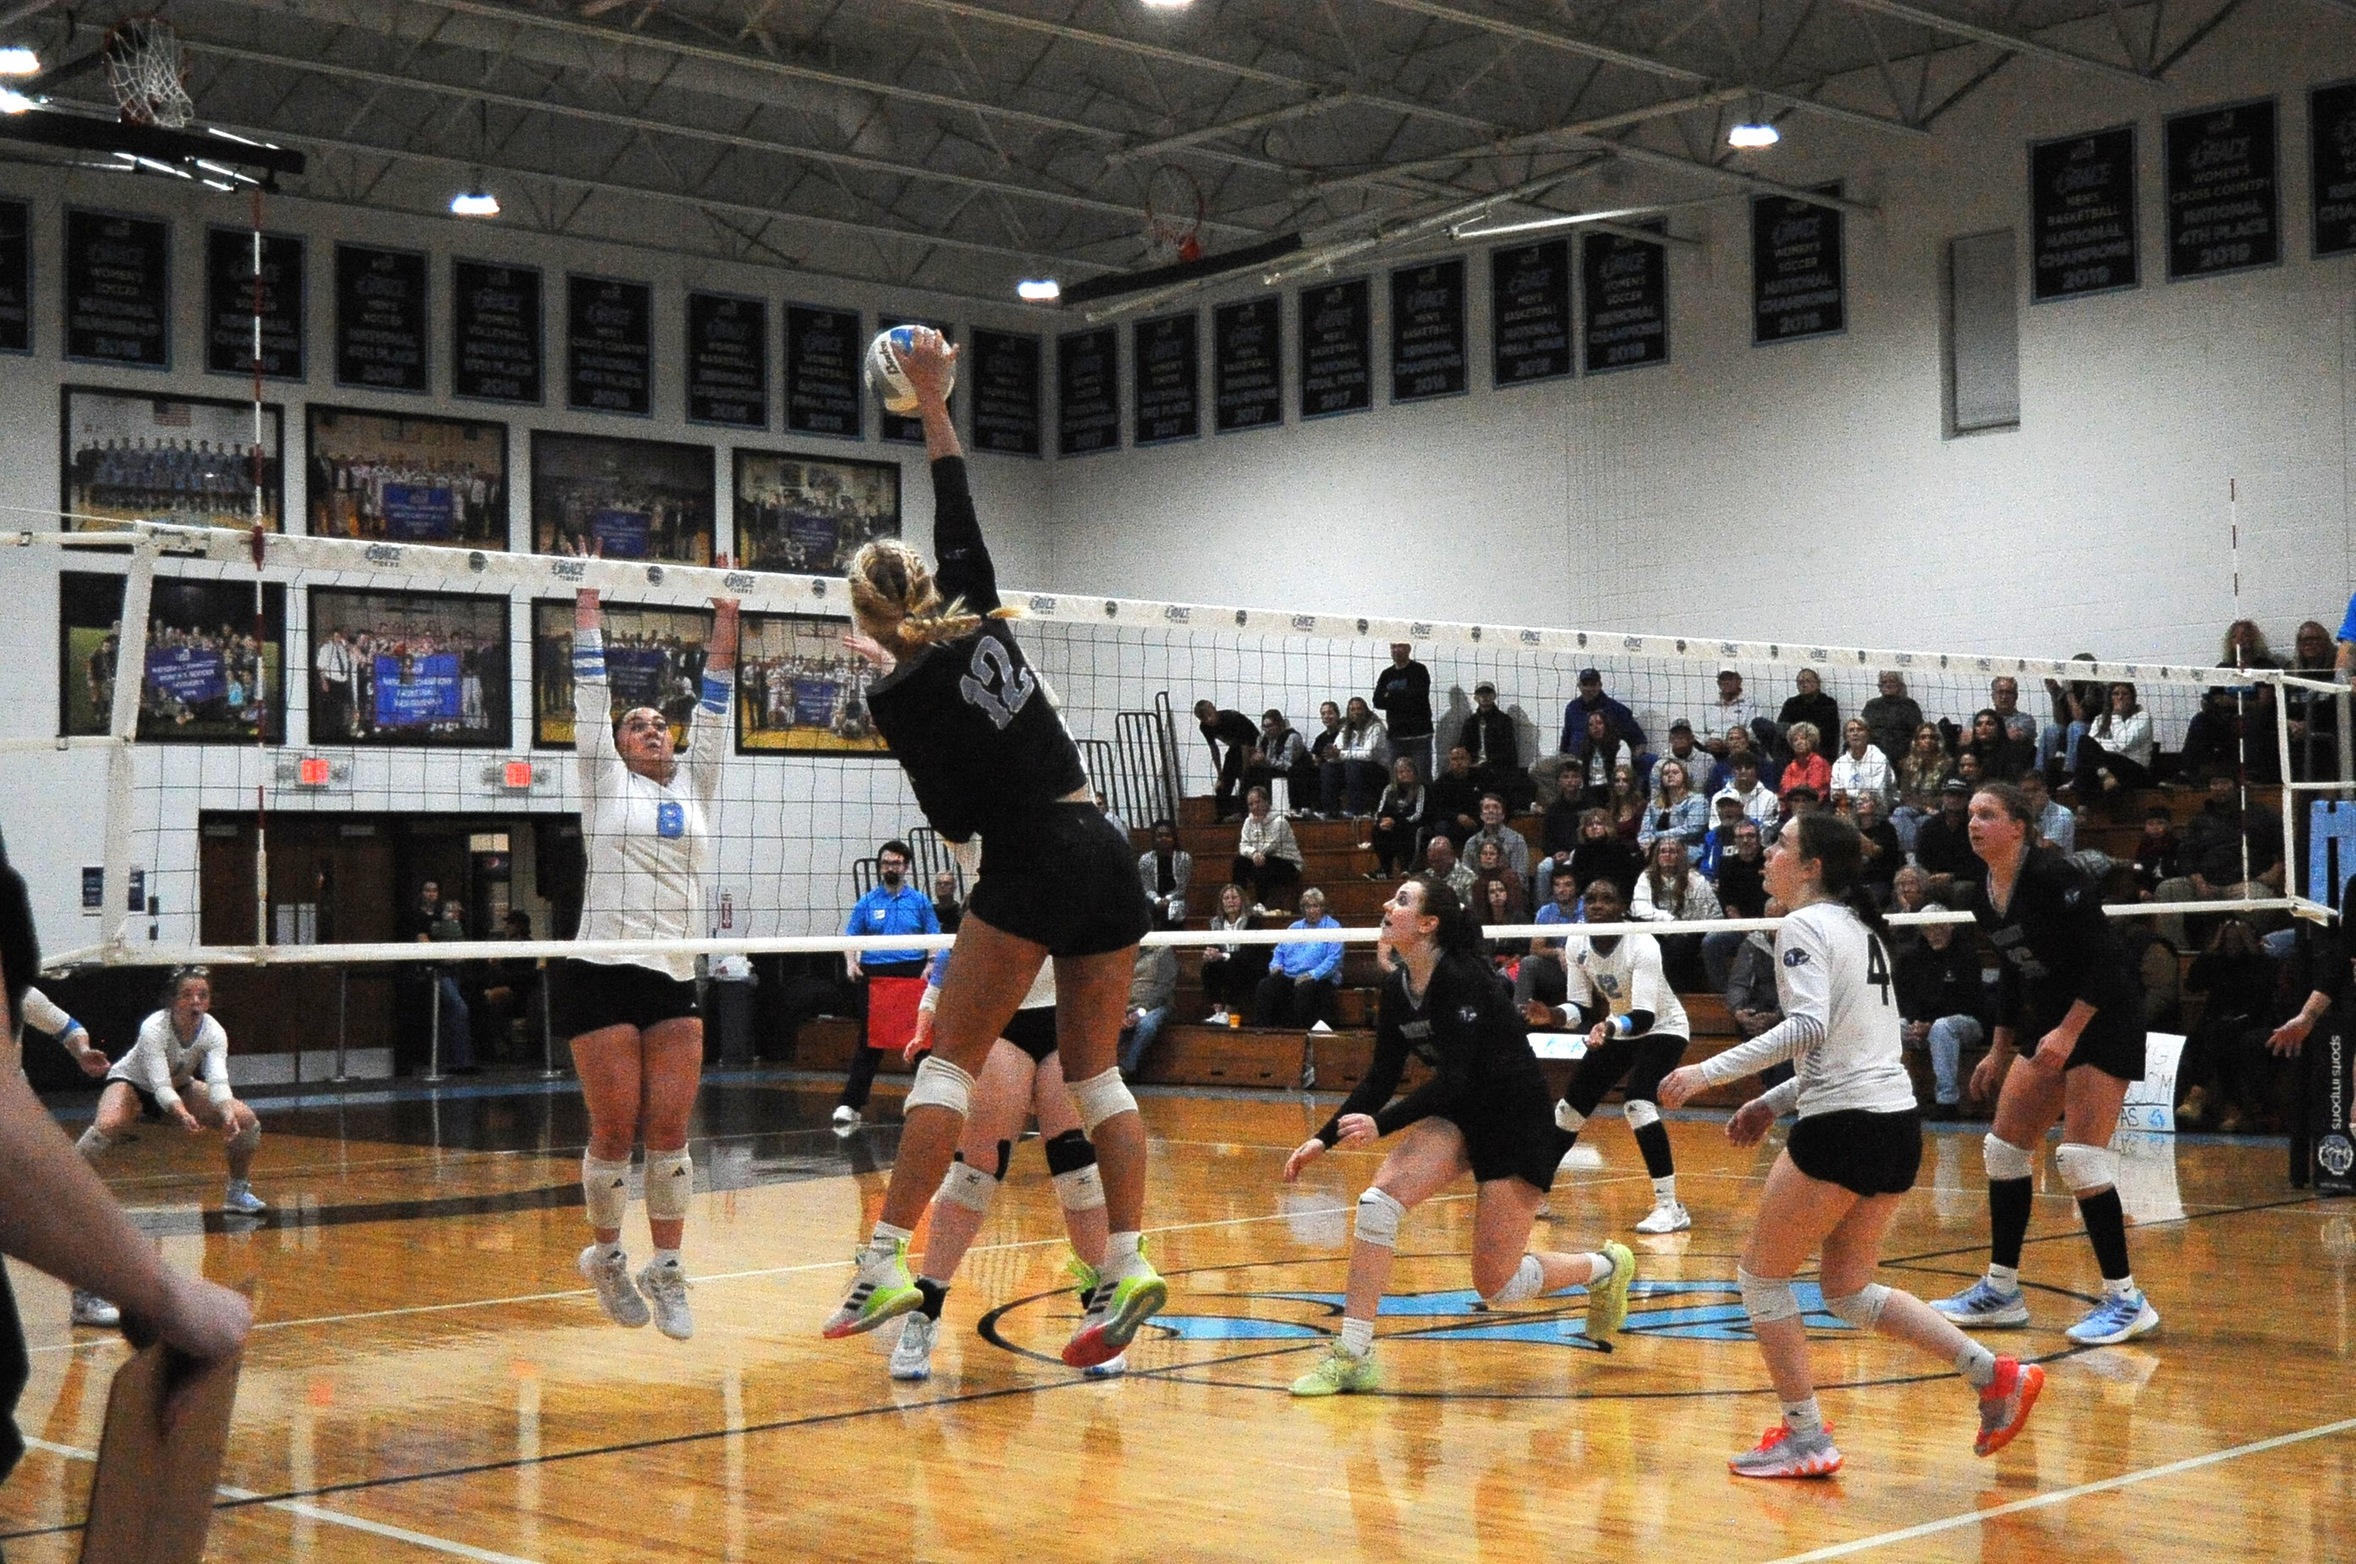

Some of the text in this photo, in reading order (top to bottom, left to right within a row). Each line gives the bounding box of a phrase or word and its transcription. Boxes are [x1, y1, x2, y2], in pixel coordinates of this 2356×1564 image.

[2192, 164, 2250, 184] WOMEN'S
[2066, 192, 2100, 207] MEN'S
[2171, 178, 2271, 204] CROSS COUNTRY
[2047, 204, 2121, 227] BASKETBALL
[2183, 198, 2263, 224] NATIONAL
[2045, 222, 2124, 249] NATIONAL
[2178, 218, 2268, 245] 4TH PLACE
[1774, 241, 1821, 258] WOMEN'S
[2038, 240, 2131, 269] CHAMPIONS
[1778, 257, 1818, 273] SOCCER
[1602, 275, 1646, 292] WOMEN'S
[1764, 271, 1832, 296] NATIONAL
[1606, 290, 1643, 305] SOCCER
[1758, 289, 1838, 314] CHAMPIONS
[1504, 304, 1557, 322] BASKETBALL
[1402, 323, 1452, 339] BASKETBALL
[551, 560, 587, 576] GRACE
[723, 572, 756, 588] GRACE
[960, 635, 1034, 730] 12
[656, 802, 685, 840] 8
[1867, 934, 1890, 1006] 4
[2329, 1034, 2342, 1130] sports imports
